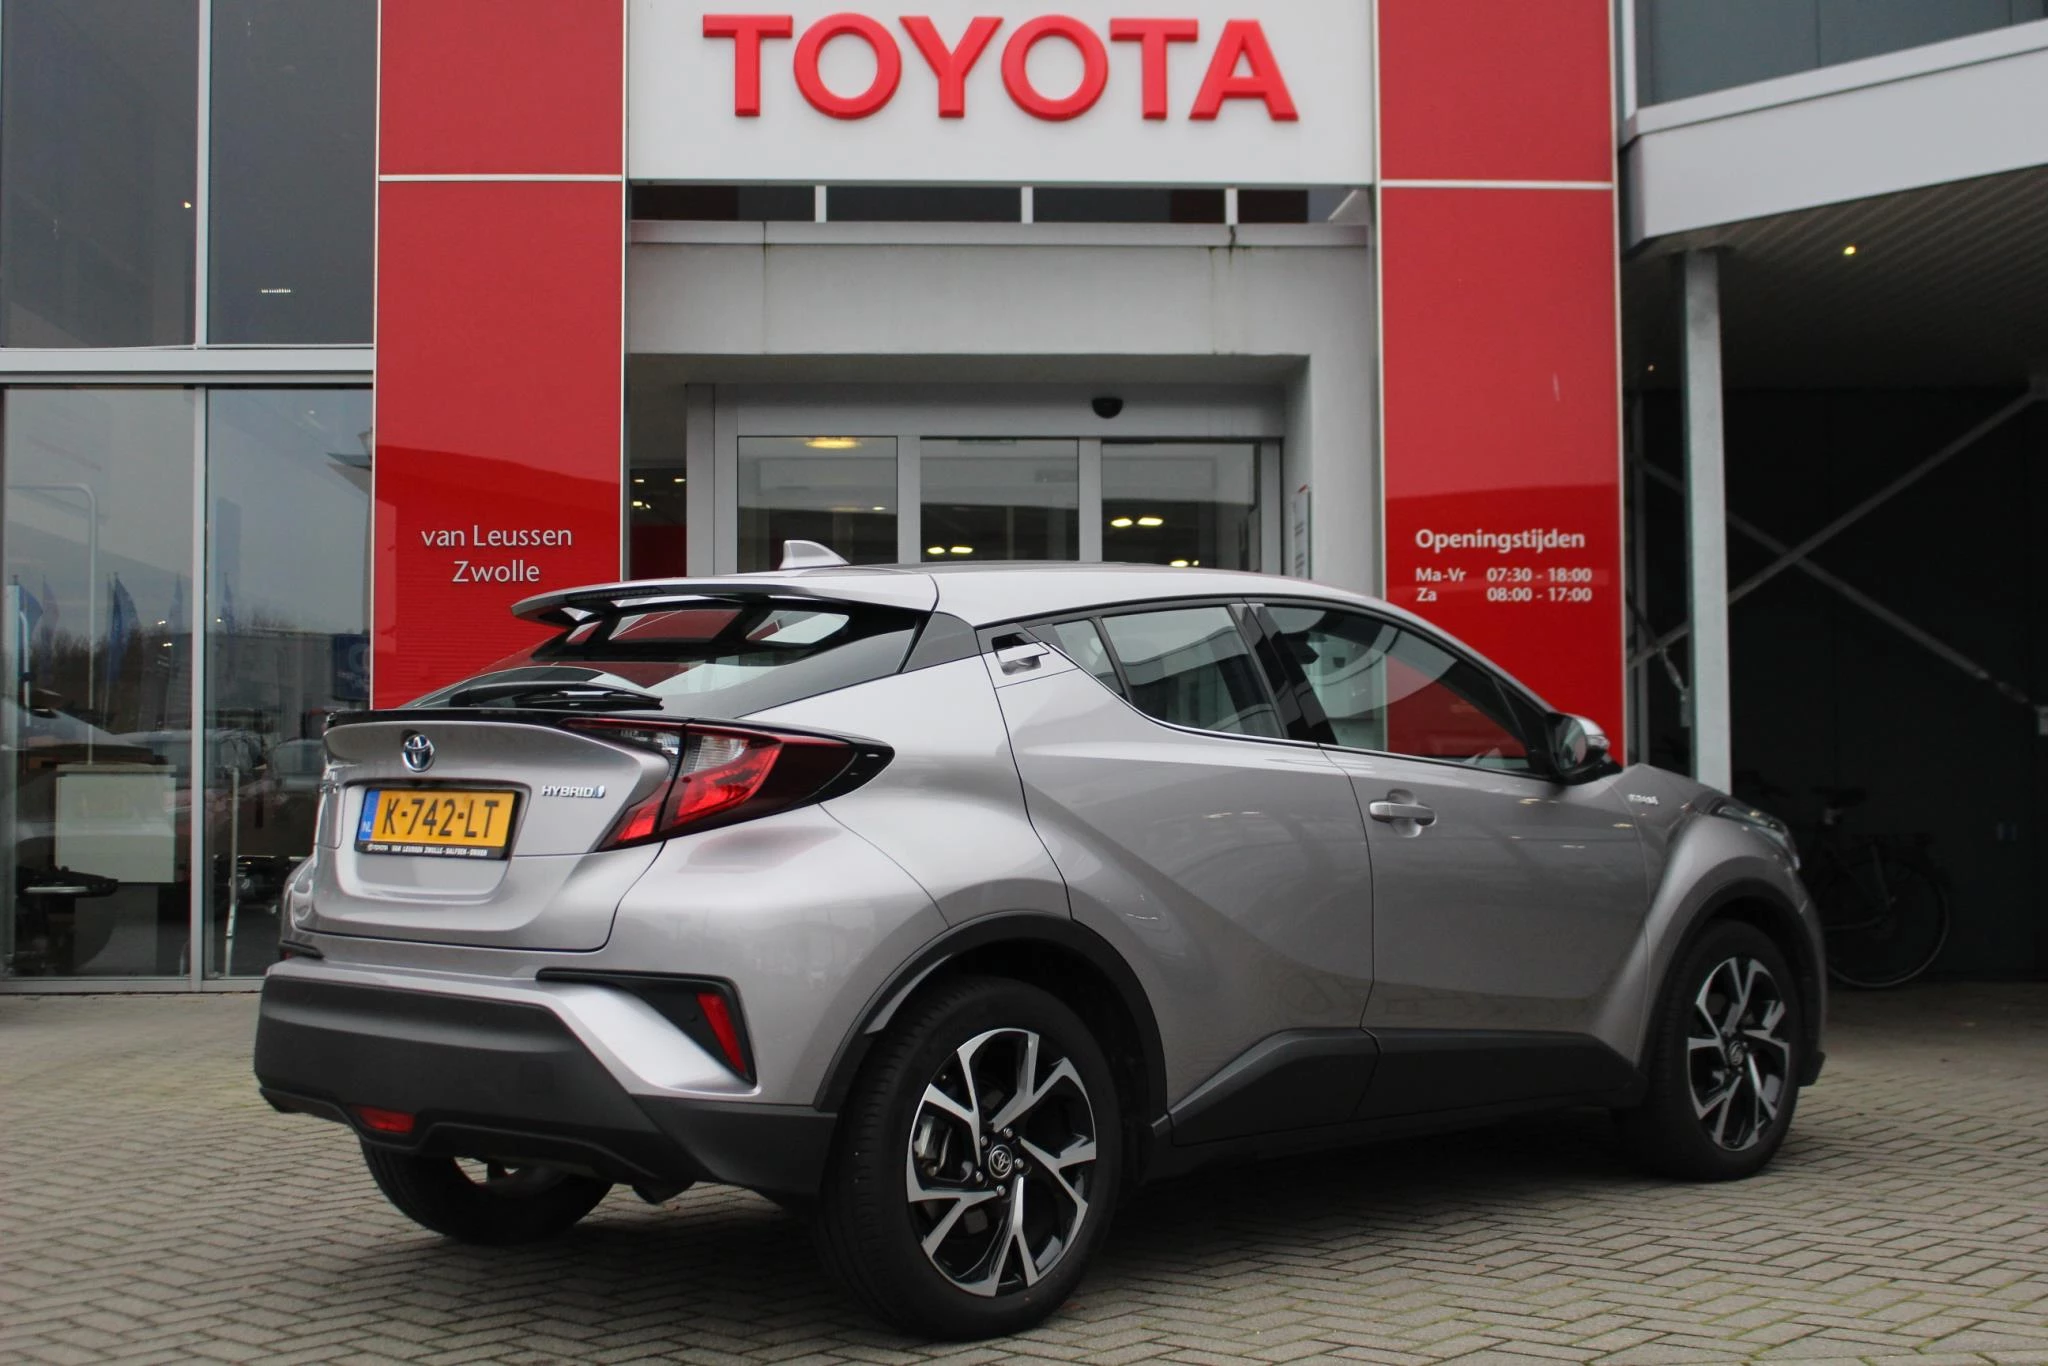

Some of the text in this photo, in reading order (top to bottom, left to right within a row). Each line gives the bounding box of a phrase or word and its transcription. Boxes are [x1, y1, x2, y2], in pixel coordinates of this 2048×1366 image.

[702, 12, 1300, 122] TOYOTA
[421, 524, 573, 547] van Leussen
[1415, 528, 1586, 554] Openingstijden
[452, 559, 540, 583] Zwolle
[1415, 568, 1467, 583] Ma-Vr
[1486, 567, 1533, 583] 07:30
[1548, 567, 1593, 583] 18:00
[1416, 587, 1438, 602] Za
[1486, 587, 1533, 602] 08:00
[1548, 587, 1593, 602] 17:00
[542, 785, 595, 798] HYBRID
[361, 821, 372, 833] NL
[381, 798, 499, 838] K-742-LT
